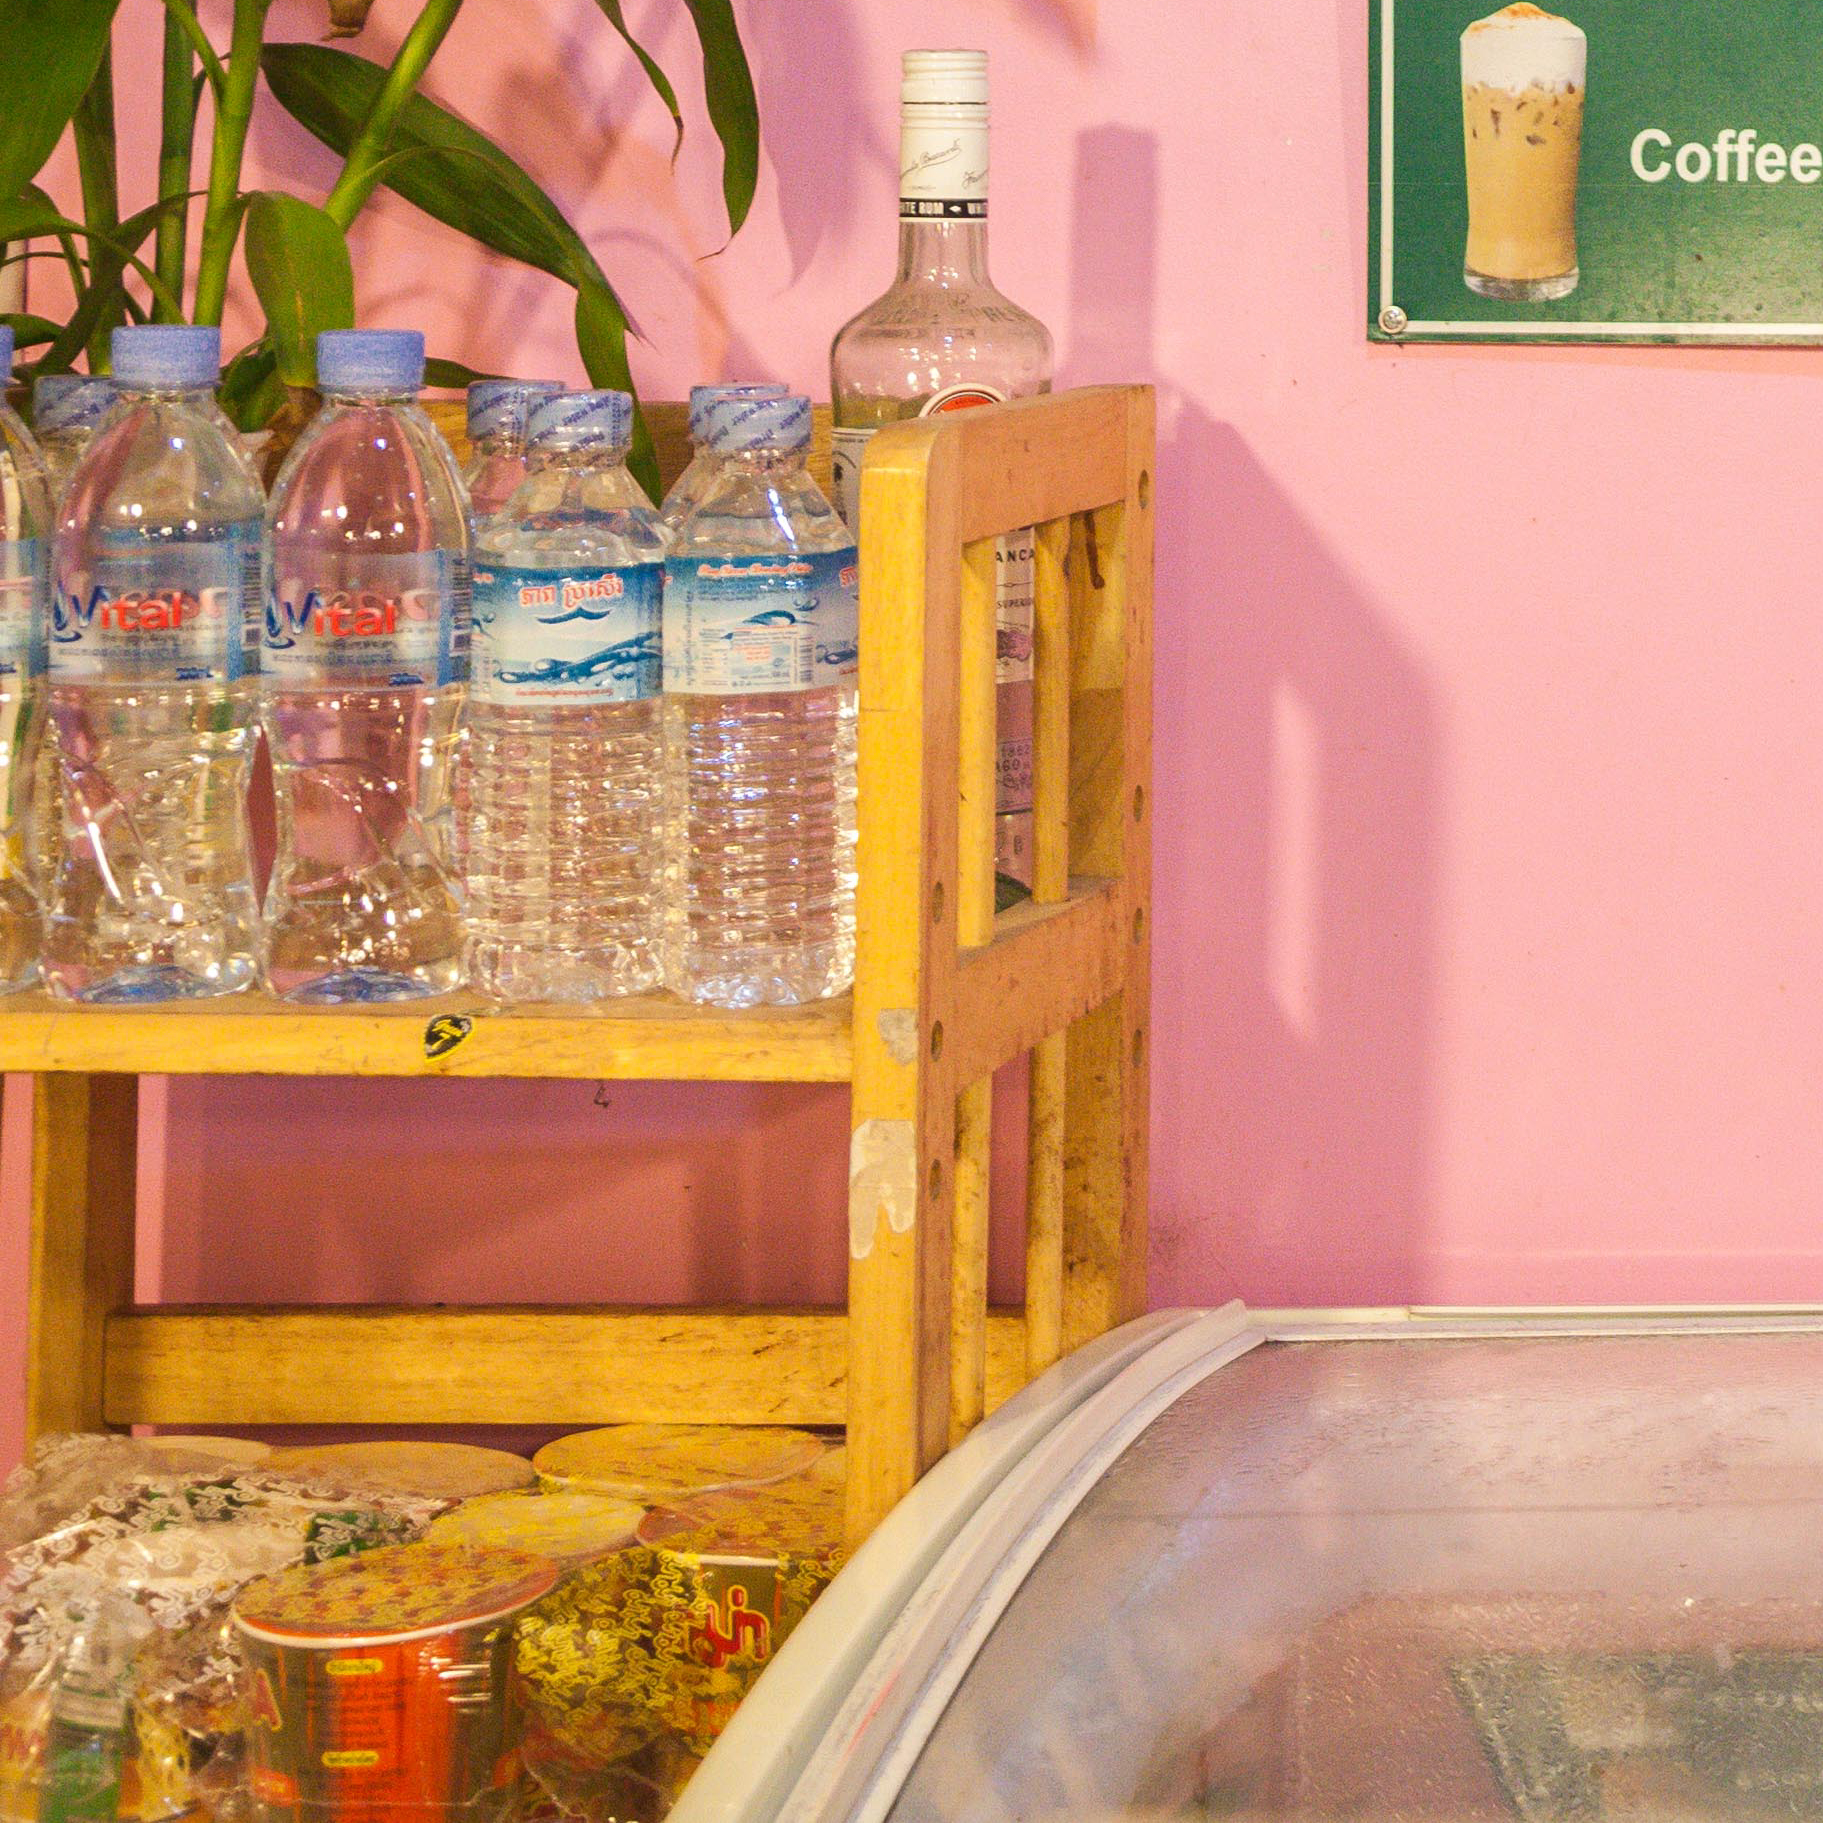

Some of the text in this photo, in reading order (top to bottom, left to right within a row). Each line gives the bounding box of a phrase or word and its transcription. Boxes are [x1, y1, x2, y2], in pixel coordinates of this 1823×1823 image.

[1630, 128, 1823, 190] Coffee
[71, 585, 184, 631] Vital
[285, 588, 399, 637] Vital
